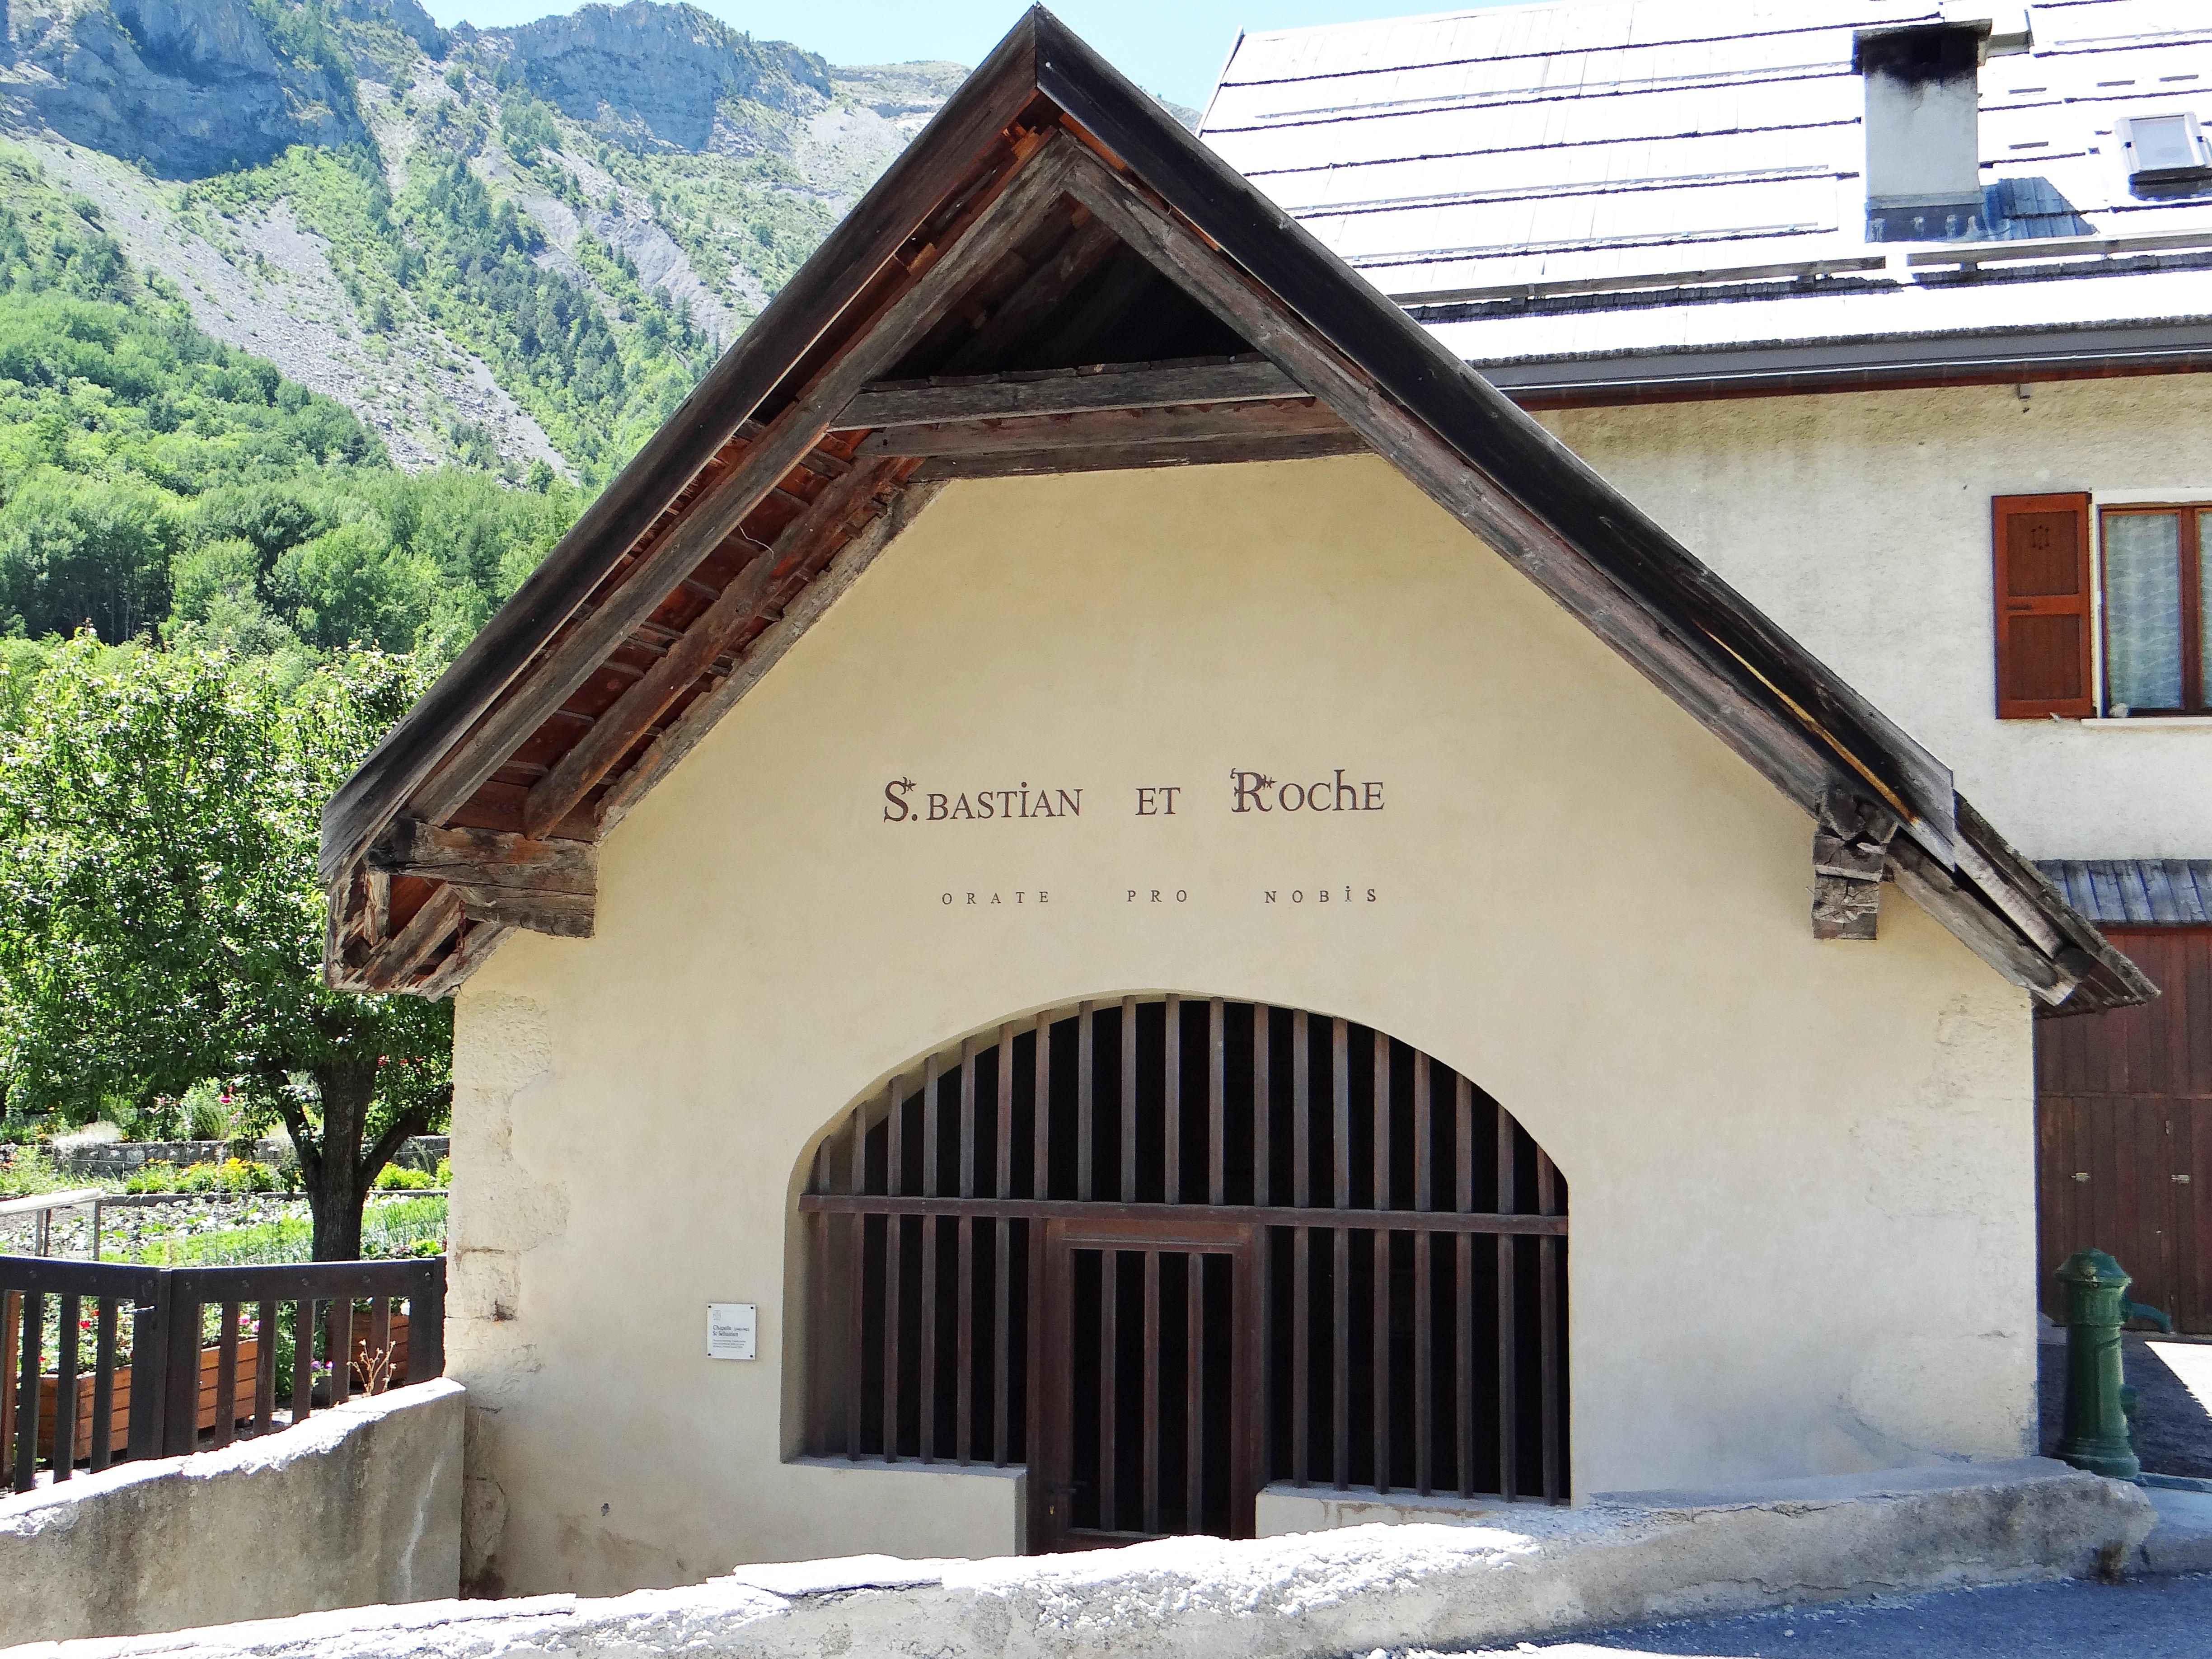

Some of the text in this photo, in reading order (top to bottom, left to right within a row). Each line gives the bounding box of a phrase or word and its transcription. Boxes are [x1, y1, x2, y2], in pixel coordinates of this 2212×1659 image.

[1135, 787, 1181, 815] ET
[941, 890, 1049, 905] ORATE
[1127, 889, 1187, 903] PRO
